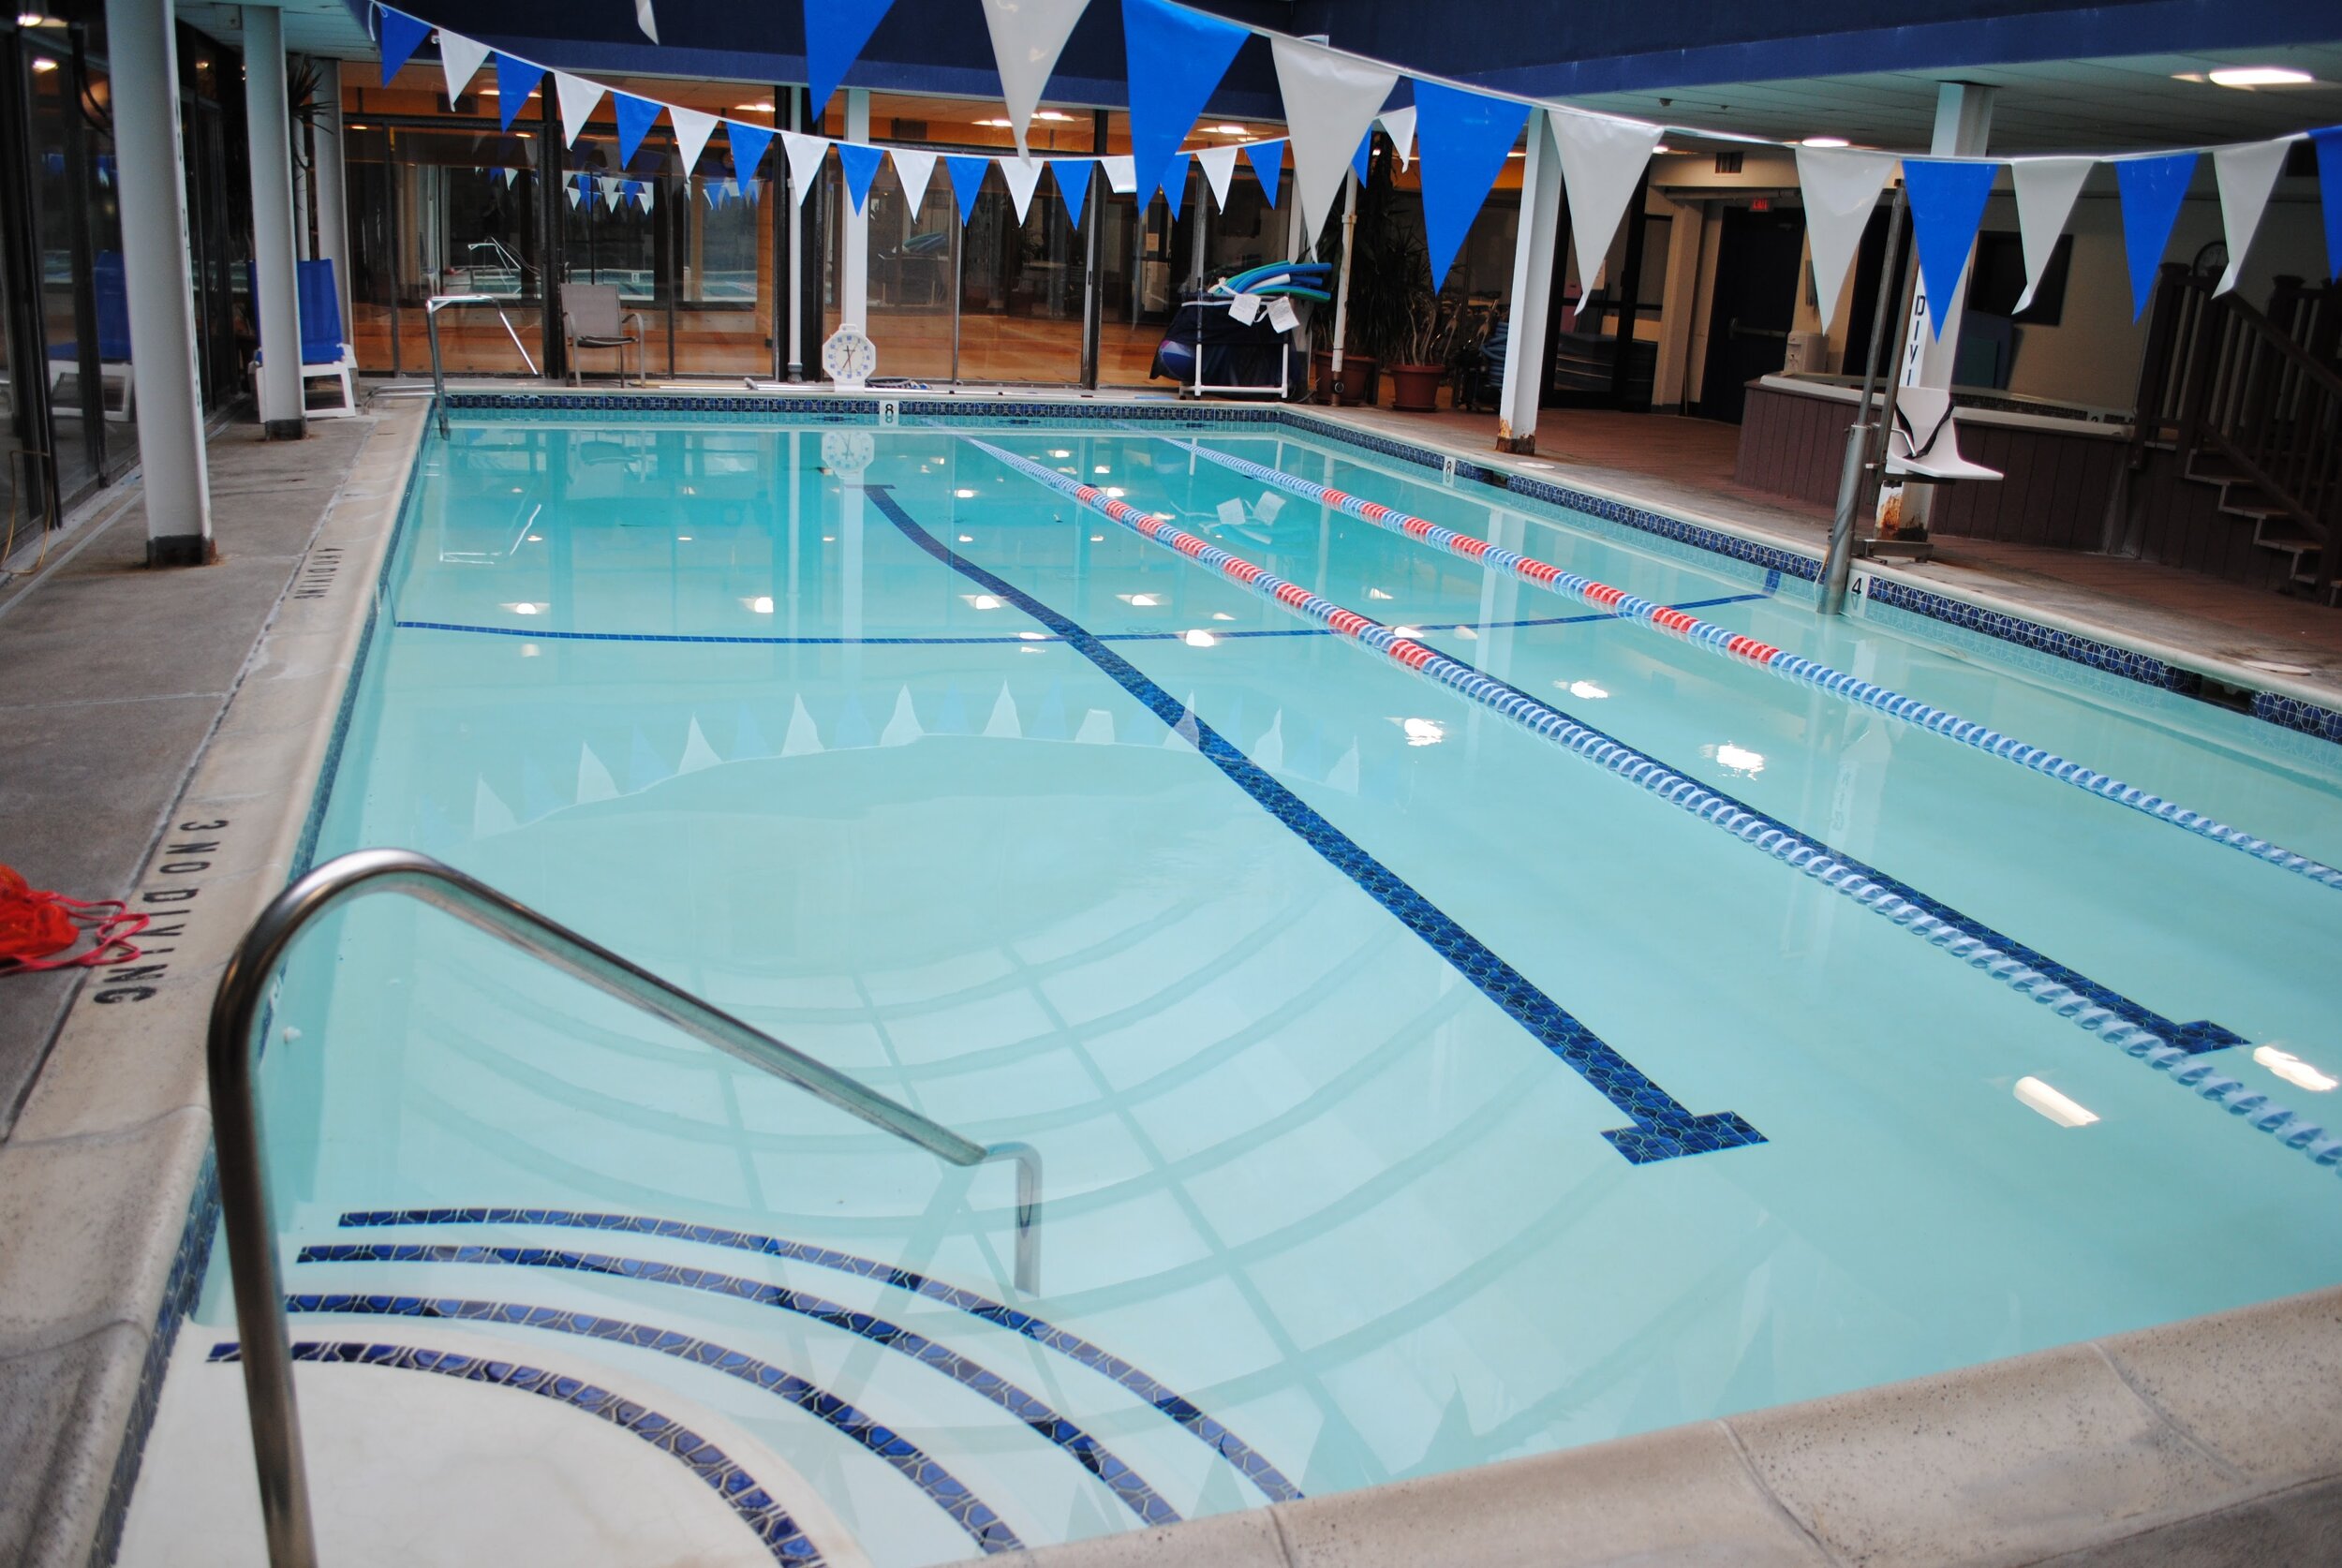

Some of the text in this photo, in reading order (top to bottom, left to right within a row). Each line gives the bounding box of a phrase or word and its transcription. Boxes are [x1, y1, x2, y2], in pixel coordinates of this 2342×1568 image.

[1906, 295, 1926, 386] DIVI
[293, 568, 337, 599] DIVING
[1851, 577, 1861, 595] 4
[94, 820, 230, 1004] 3 NO DIVING
